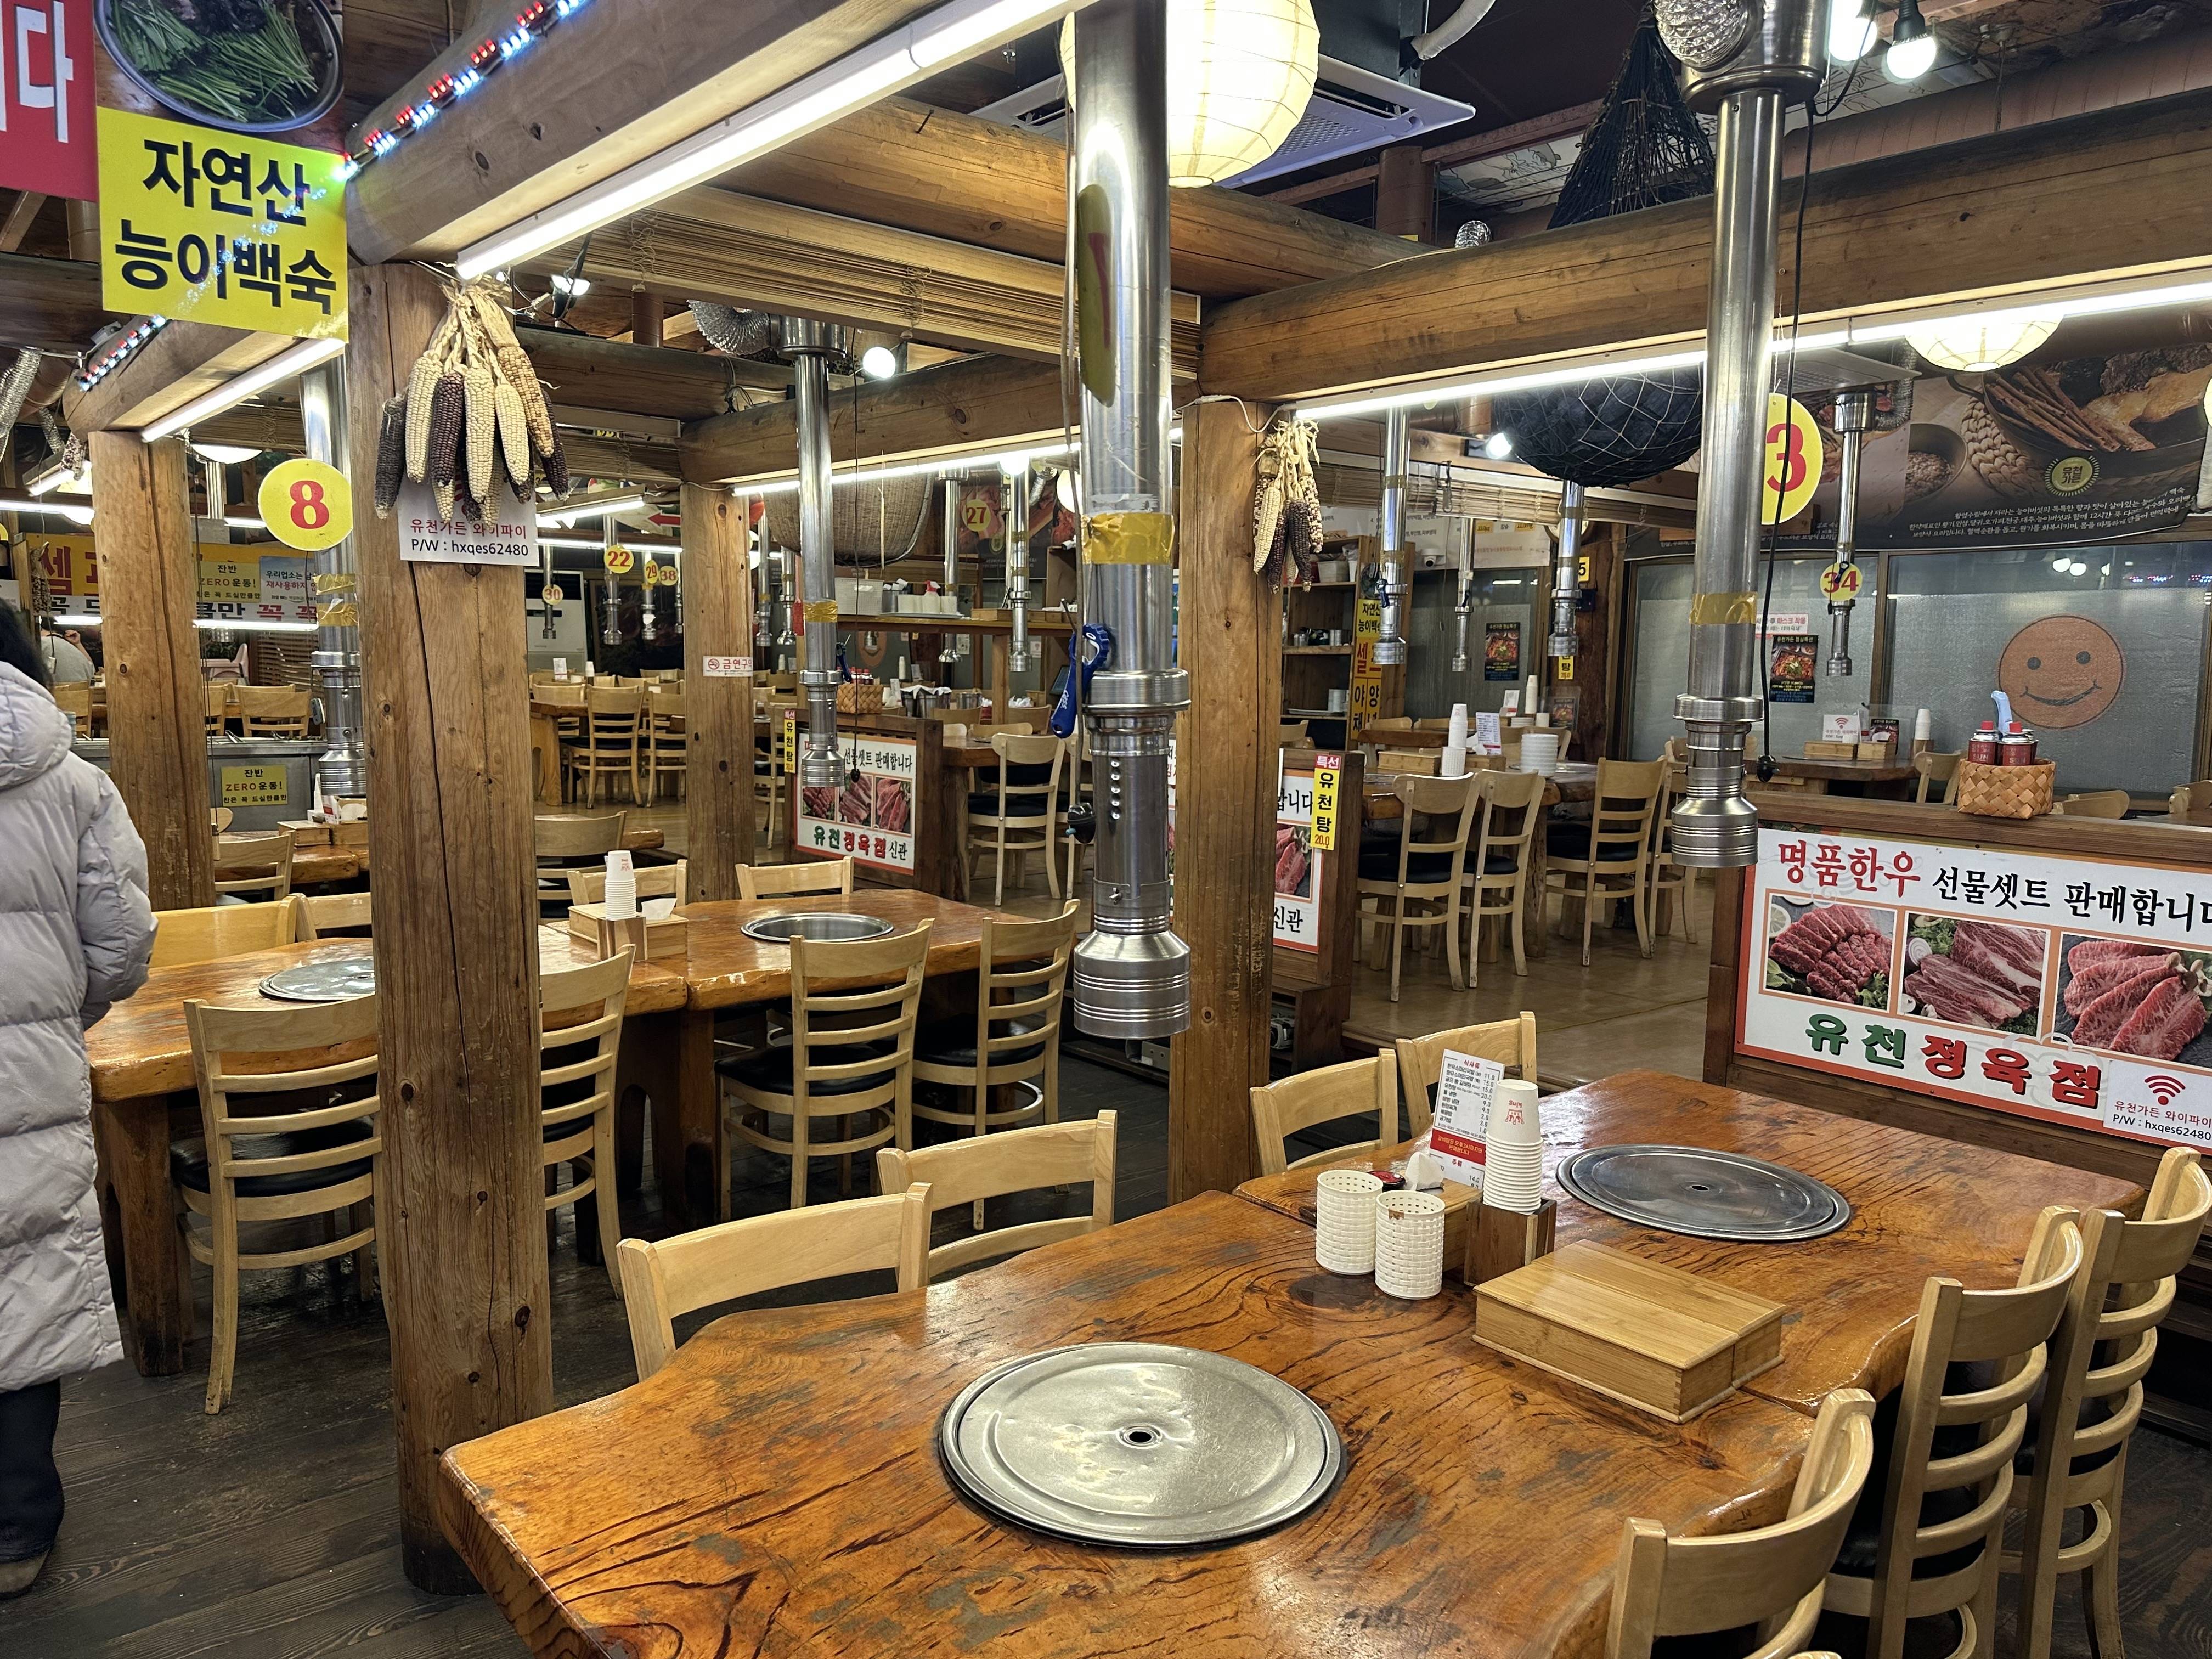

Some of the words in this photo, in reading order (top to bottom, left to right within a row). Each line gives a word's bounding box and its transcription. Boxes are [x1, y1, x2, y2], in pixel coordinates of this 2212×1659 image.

[0, 0, 74, 143] 다
[143, 139, 311, 226] 자연산
[115, 219, 336, 315] 능이백숙
[290, 480, 329, 529] 8
[967, 507, 987, 524] 27
[410, 518, 467, 535] 유천가든
[411, 538, 439, 551] P/W
[452, 540, 528, 556] hxqes62480
[608, 551, 630, 567] 22
[217, 565, 238, 574] 잔반
[646, 565, 658, 579] 29
[660, 570, 676, 582] 38
[1823, 570, 1859, 594] 34
[545, 589, 561, 601] 30
[257, 605, 285, 622] 꼭
[786, 721, 794, 762] 유천탕
[875, 752, 913, 772] 판매합니다
[1317, 755, 1340, 769] 특선
[244, 769, 263, 778] 잔반
[1317, 772, 1334, 833] 유천탕
[889, 840, 908, 861] 신관
[1778, 839, 1921, 898] 명품한우
[1933, 867, 2051, 910] 선물셋트
[1273, 906, 1304, 933] 신관
[2114, 1101, 2160, 1118] 유천가든
[2165, 1110, 2211, 1128] 와이파이
[2113, 1114, 2135, 1125] P/W
[2145, 1119, 2211, 1141] hxqes62480
[1469, 1175, 1480, 1183] 14.0
